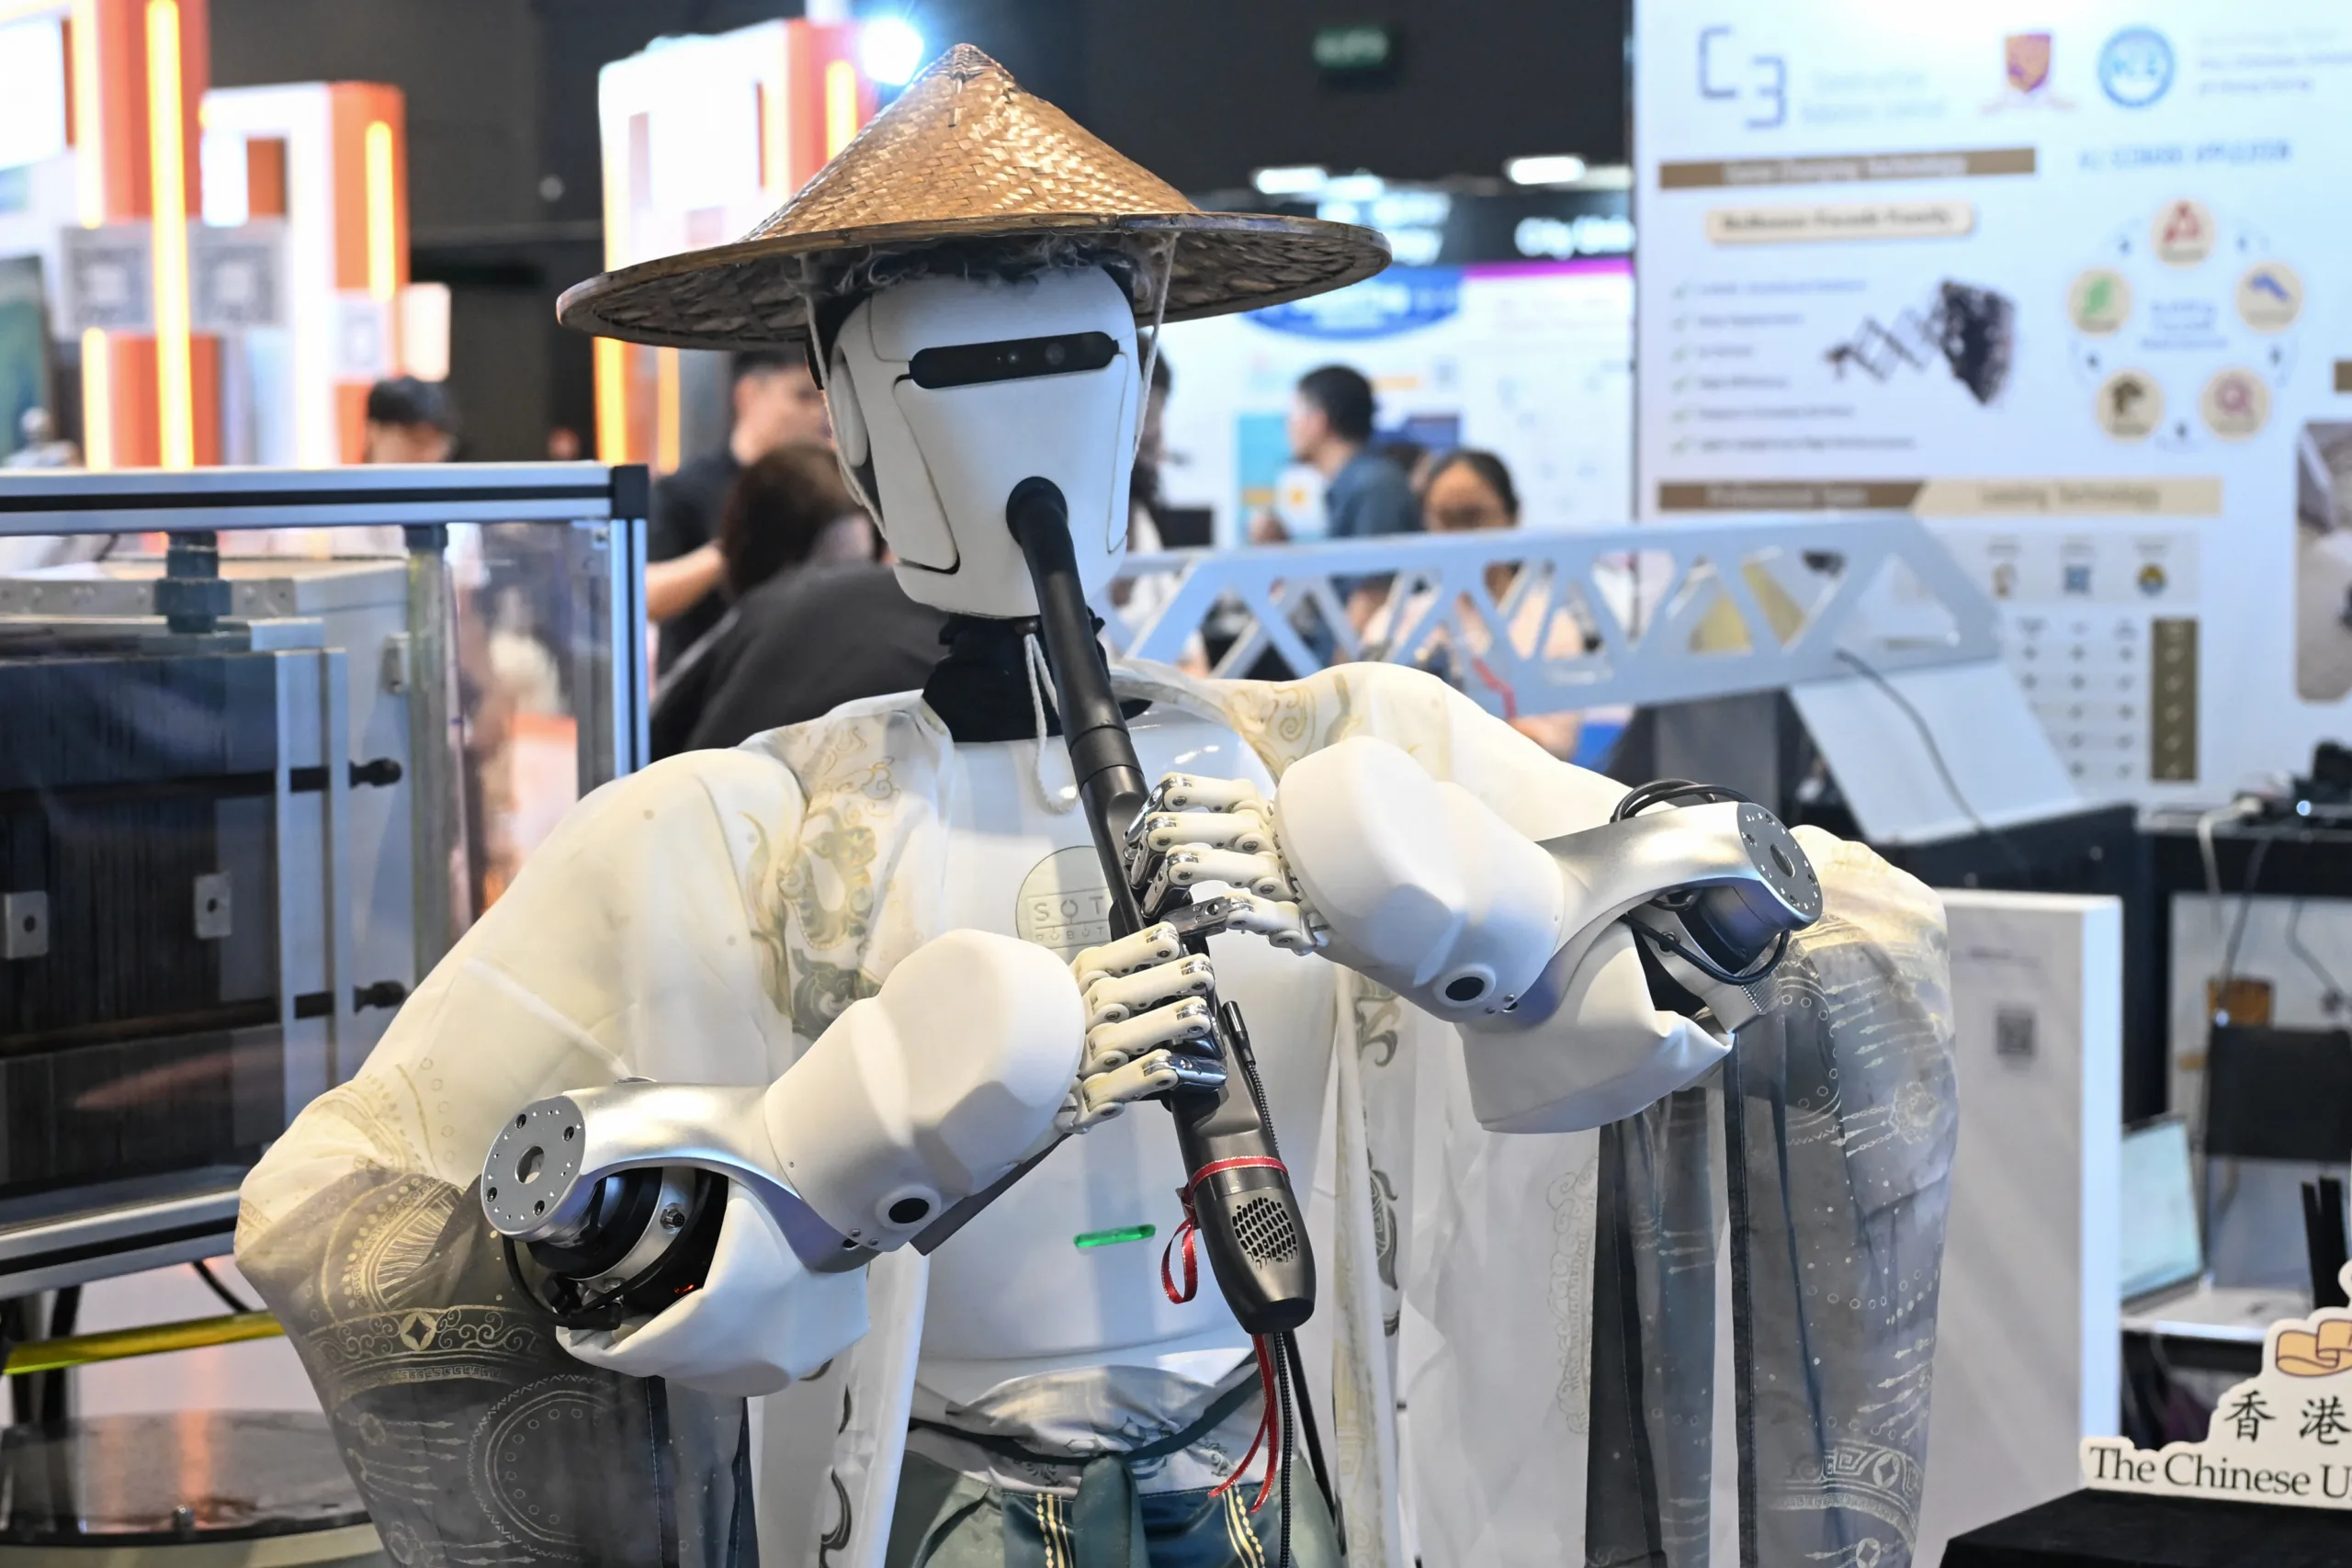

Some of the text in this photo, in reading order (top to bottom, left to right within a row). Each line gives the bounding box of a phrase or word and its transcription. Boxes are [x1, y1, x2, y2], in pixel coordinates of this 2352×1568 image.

[2224, 1390, 2352, 1445] 香港
[2090, 1446, 2155, 1483] The
[2165, 1452, 2311, 1495] Chinese
